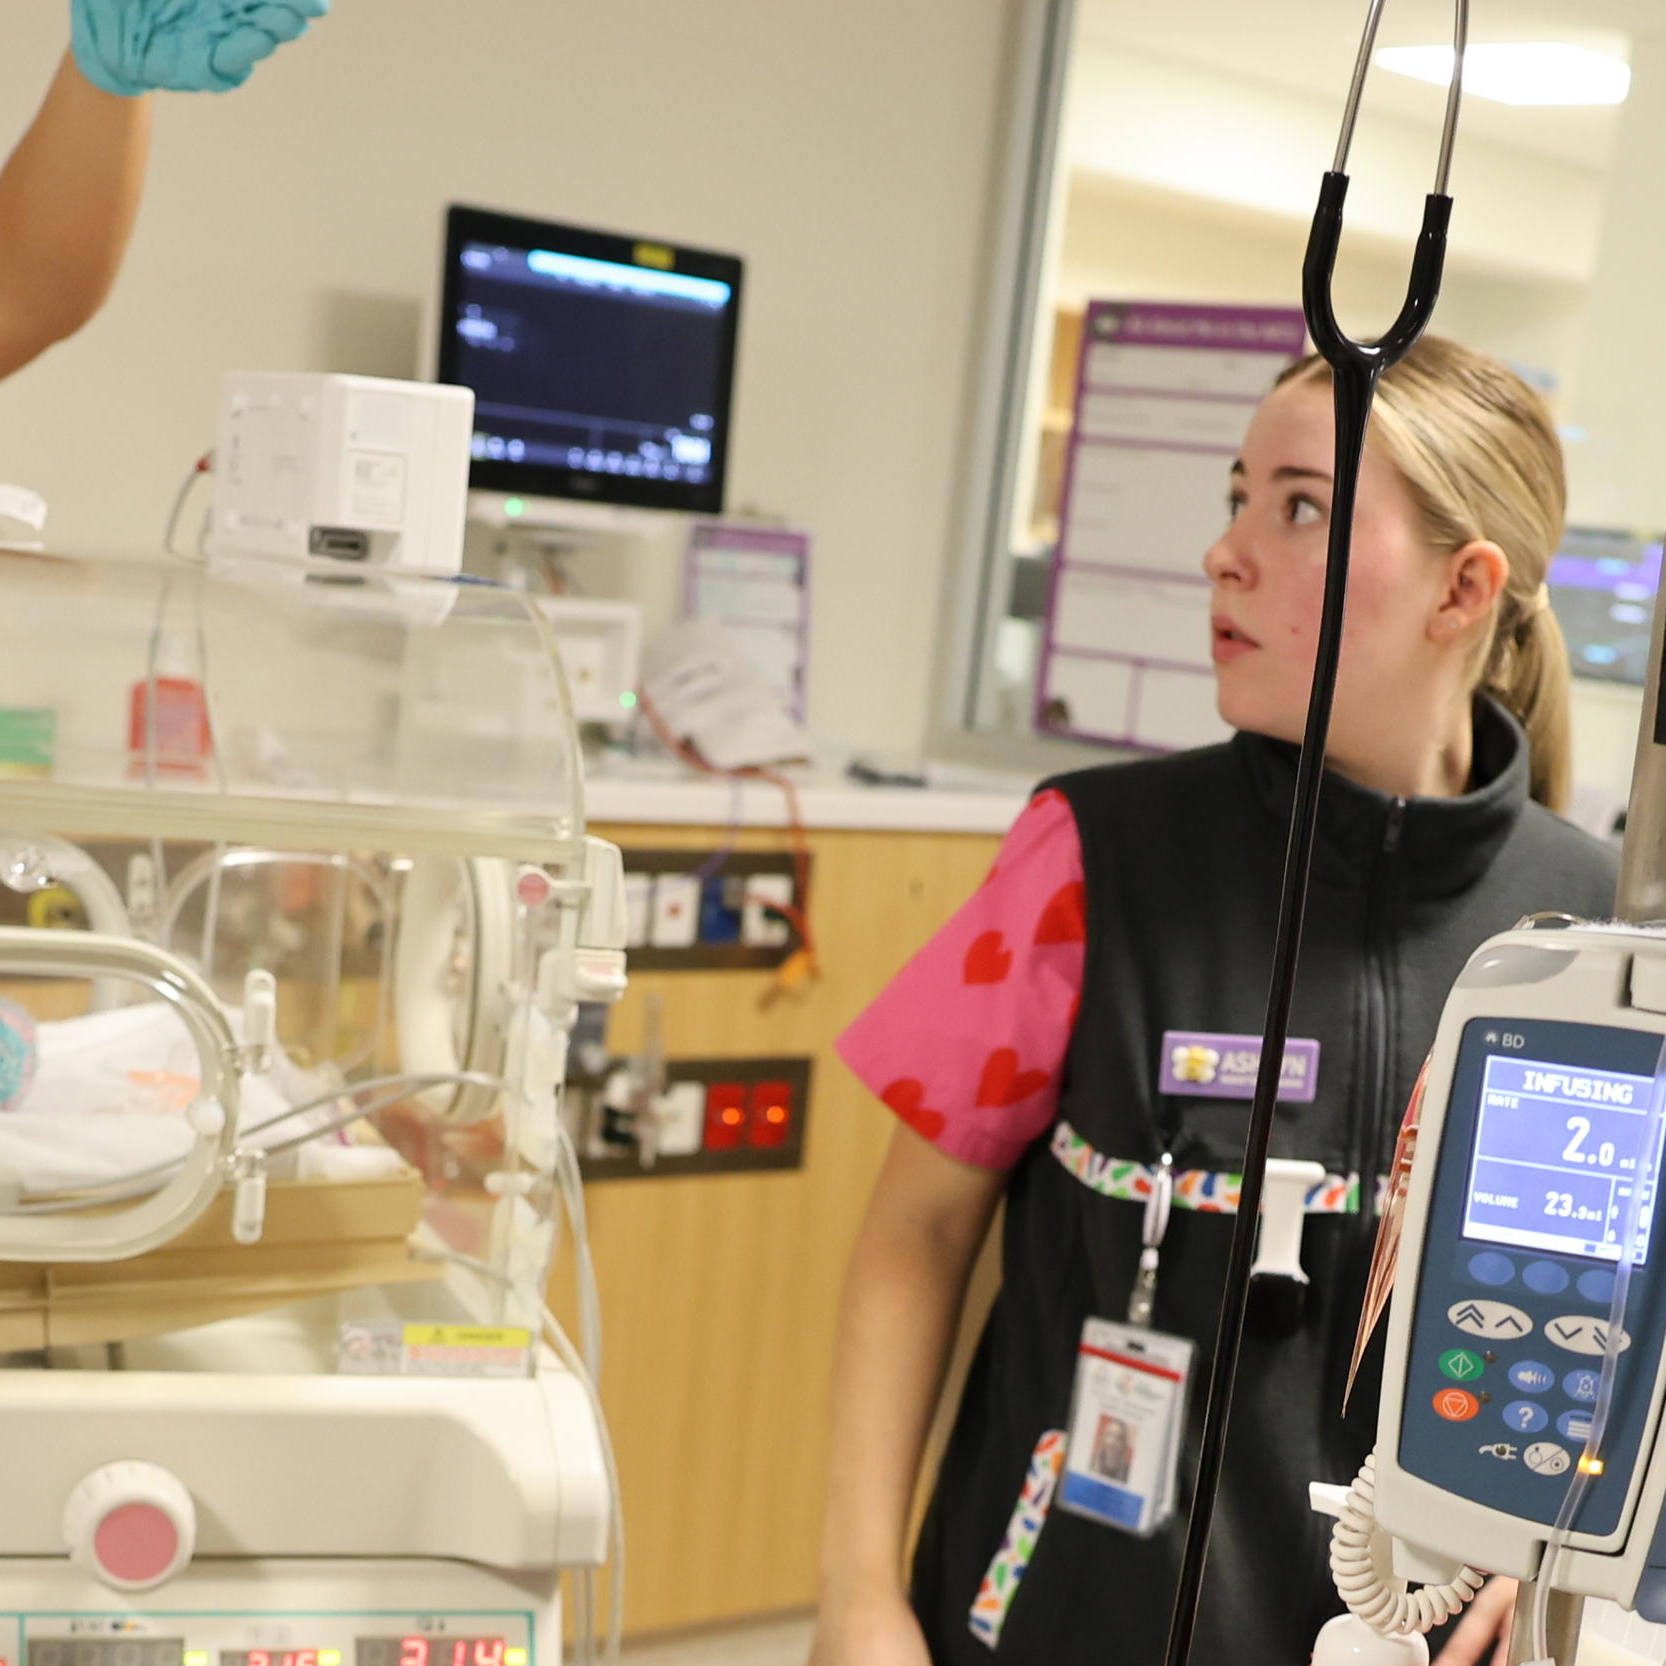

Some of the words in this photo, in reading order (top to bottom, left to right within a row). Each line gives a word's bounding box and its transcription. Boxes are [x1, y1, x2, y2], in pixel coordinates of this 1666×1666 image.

[1502, 1033, 1525, 1049] BD
[1523, 1070, 1634, 1105] INFUSING
[1562, 1116, 1615, 1167] 2.0
[1473, 1191, 1520, 1208] VOLUME
